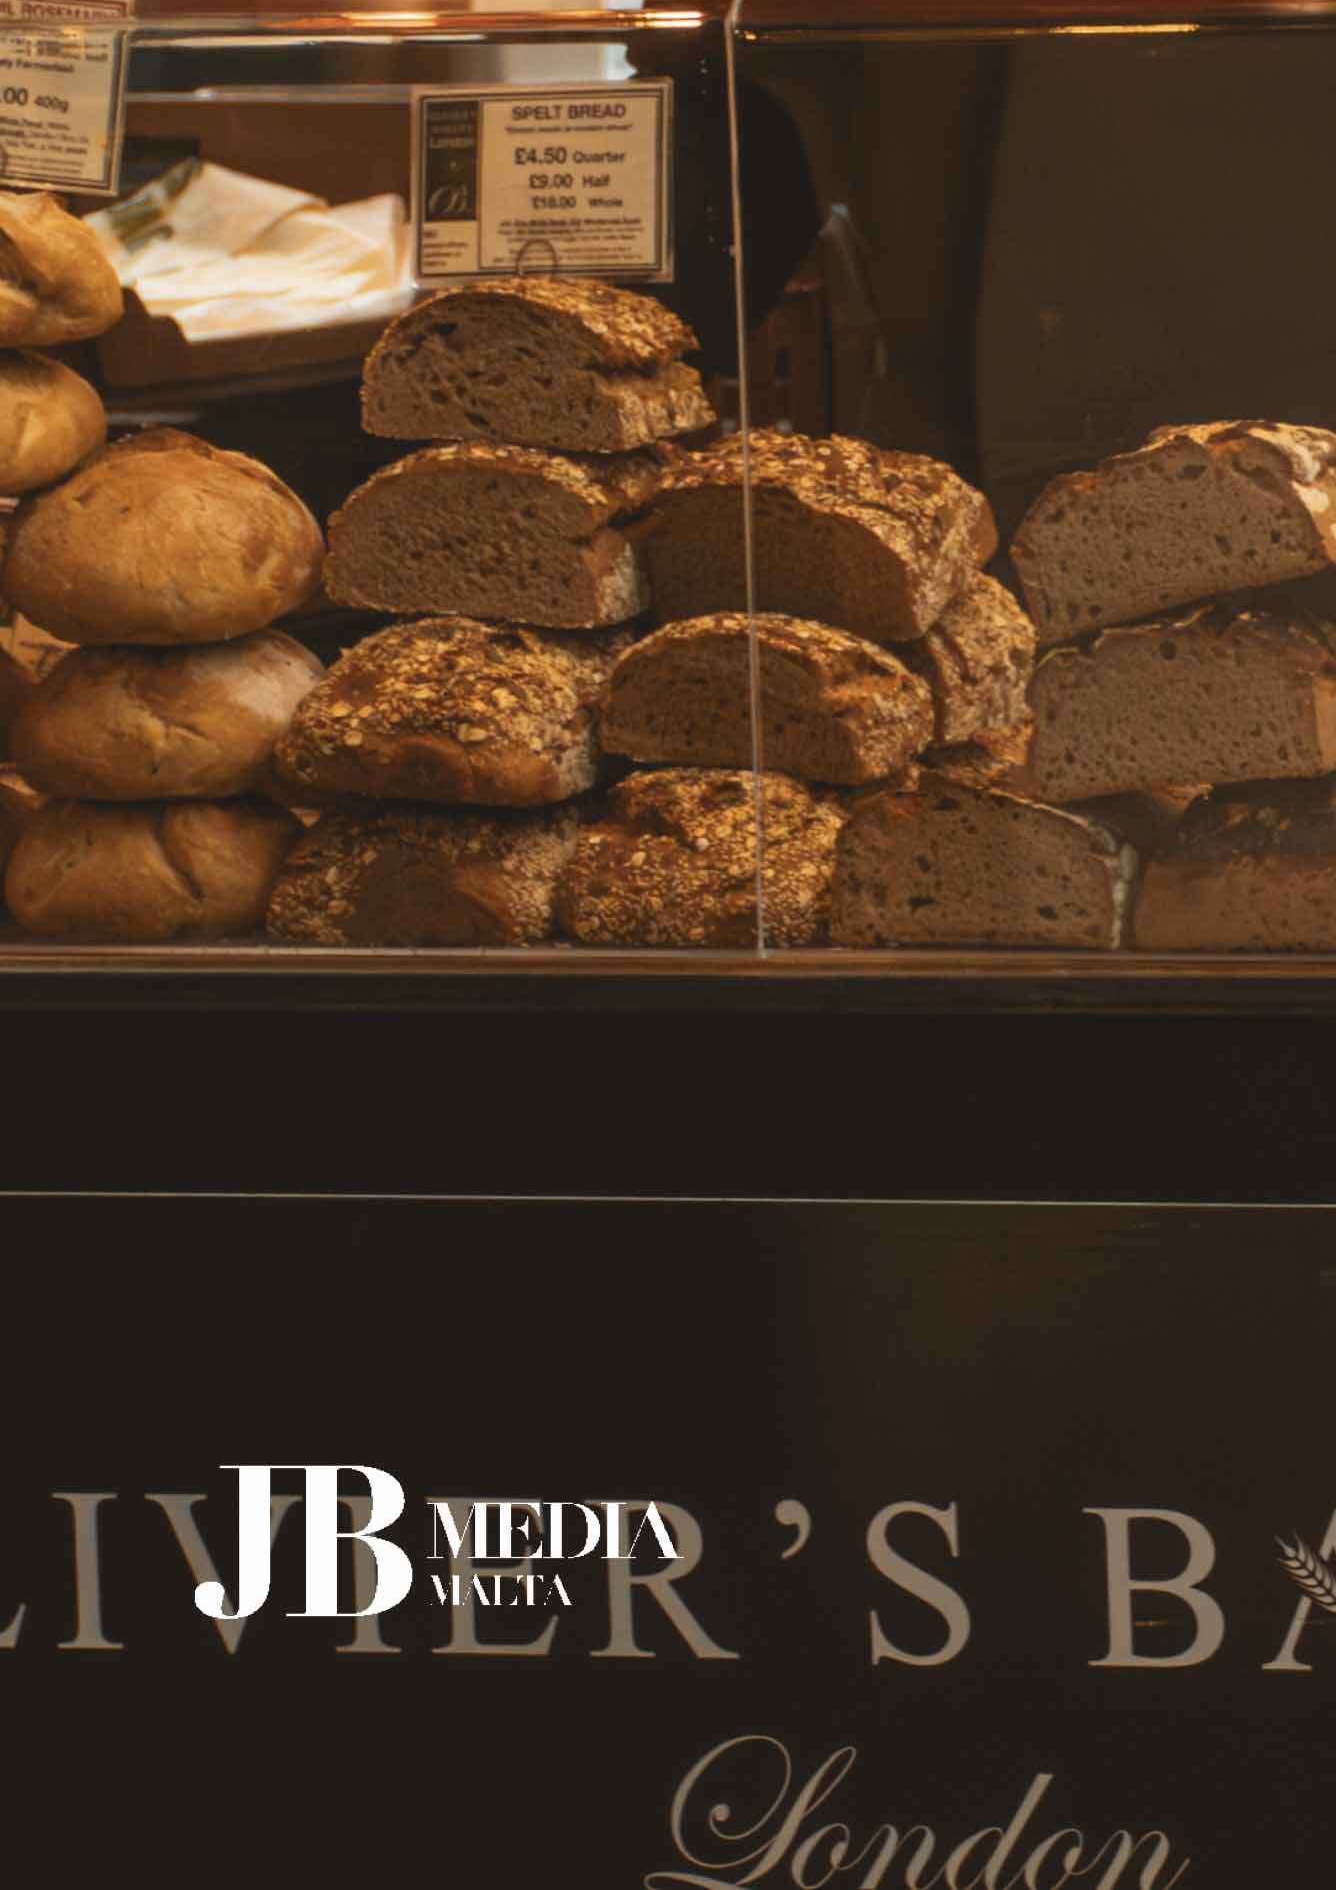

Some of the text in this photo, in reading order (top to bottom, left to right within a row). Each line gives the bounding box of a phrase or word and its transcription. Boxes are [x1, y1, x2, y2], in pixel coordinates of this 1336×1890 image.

[512, 103, 627, 121] SPELT BREAD
[514, 146, 627, 166] £4.50 Quarter
[528, 173, 611, 190] £9.00 Half
[644, 1734, 1190, 1890] London
